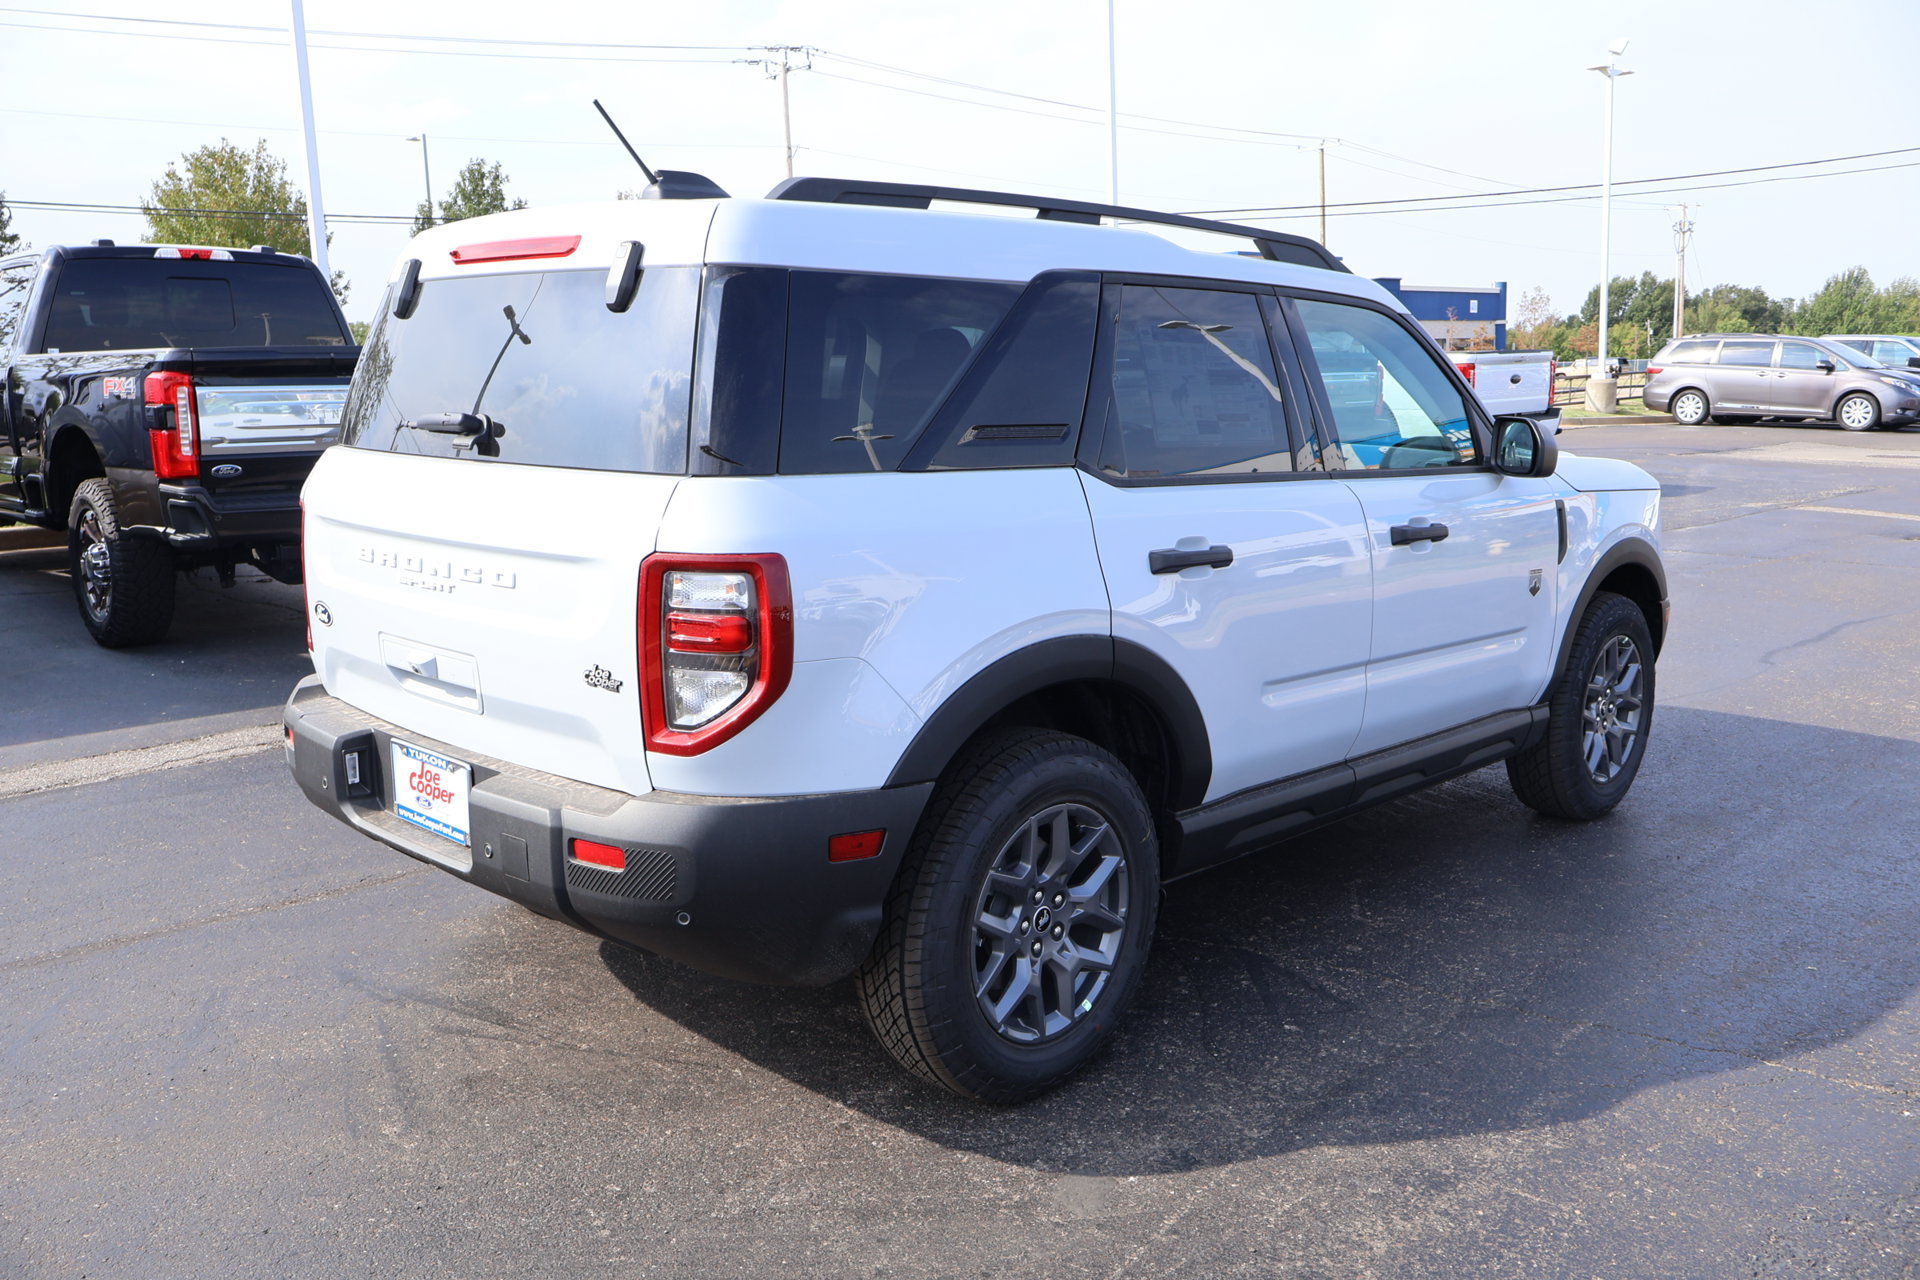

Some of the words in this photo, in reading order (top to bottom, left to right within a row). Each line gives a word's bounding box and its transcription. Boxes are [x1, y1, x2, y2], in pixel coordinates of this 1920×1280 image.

[104, 377, 136, 399] FX4
[307, 408, 342, 420] KIN
[358, 548, 516, 590] BRONCO
[583, 670, 623, 690] Cooper
[592, 664, 611, 680] Joe
[407, 747, 447, 769] YUKON
[418, 762, 440, 785] Joe
[409, 772, 454, 804] Cooper
